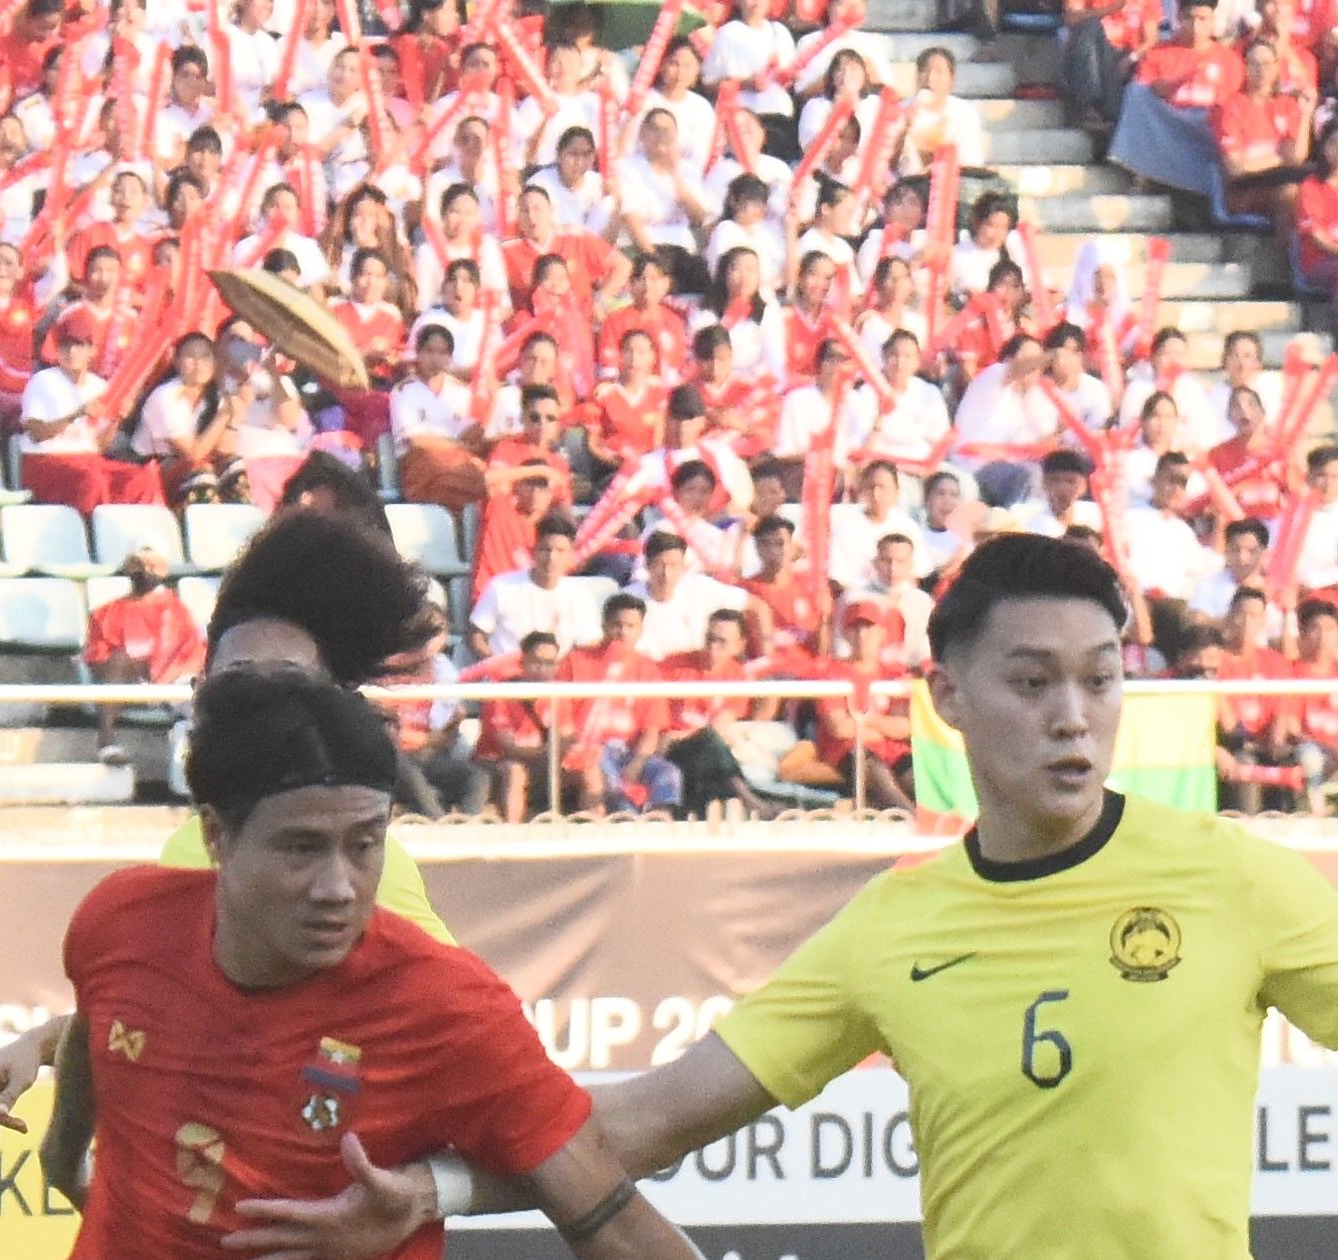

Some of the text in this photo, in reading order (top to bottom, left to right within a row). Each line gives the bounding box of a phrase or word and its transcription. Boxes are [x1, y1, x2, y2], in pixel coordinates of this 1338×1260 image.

[521, 996, 641, 1068] UP
[1020, 988, 1073, 1089] 6
[174, 1121, 226, 1224] 9
[647, 1112, 786, 1182] UR
